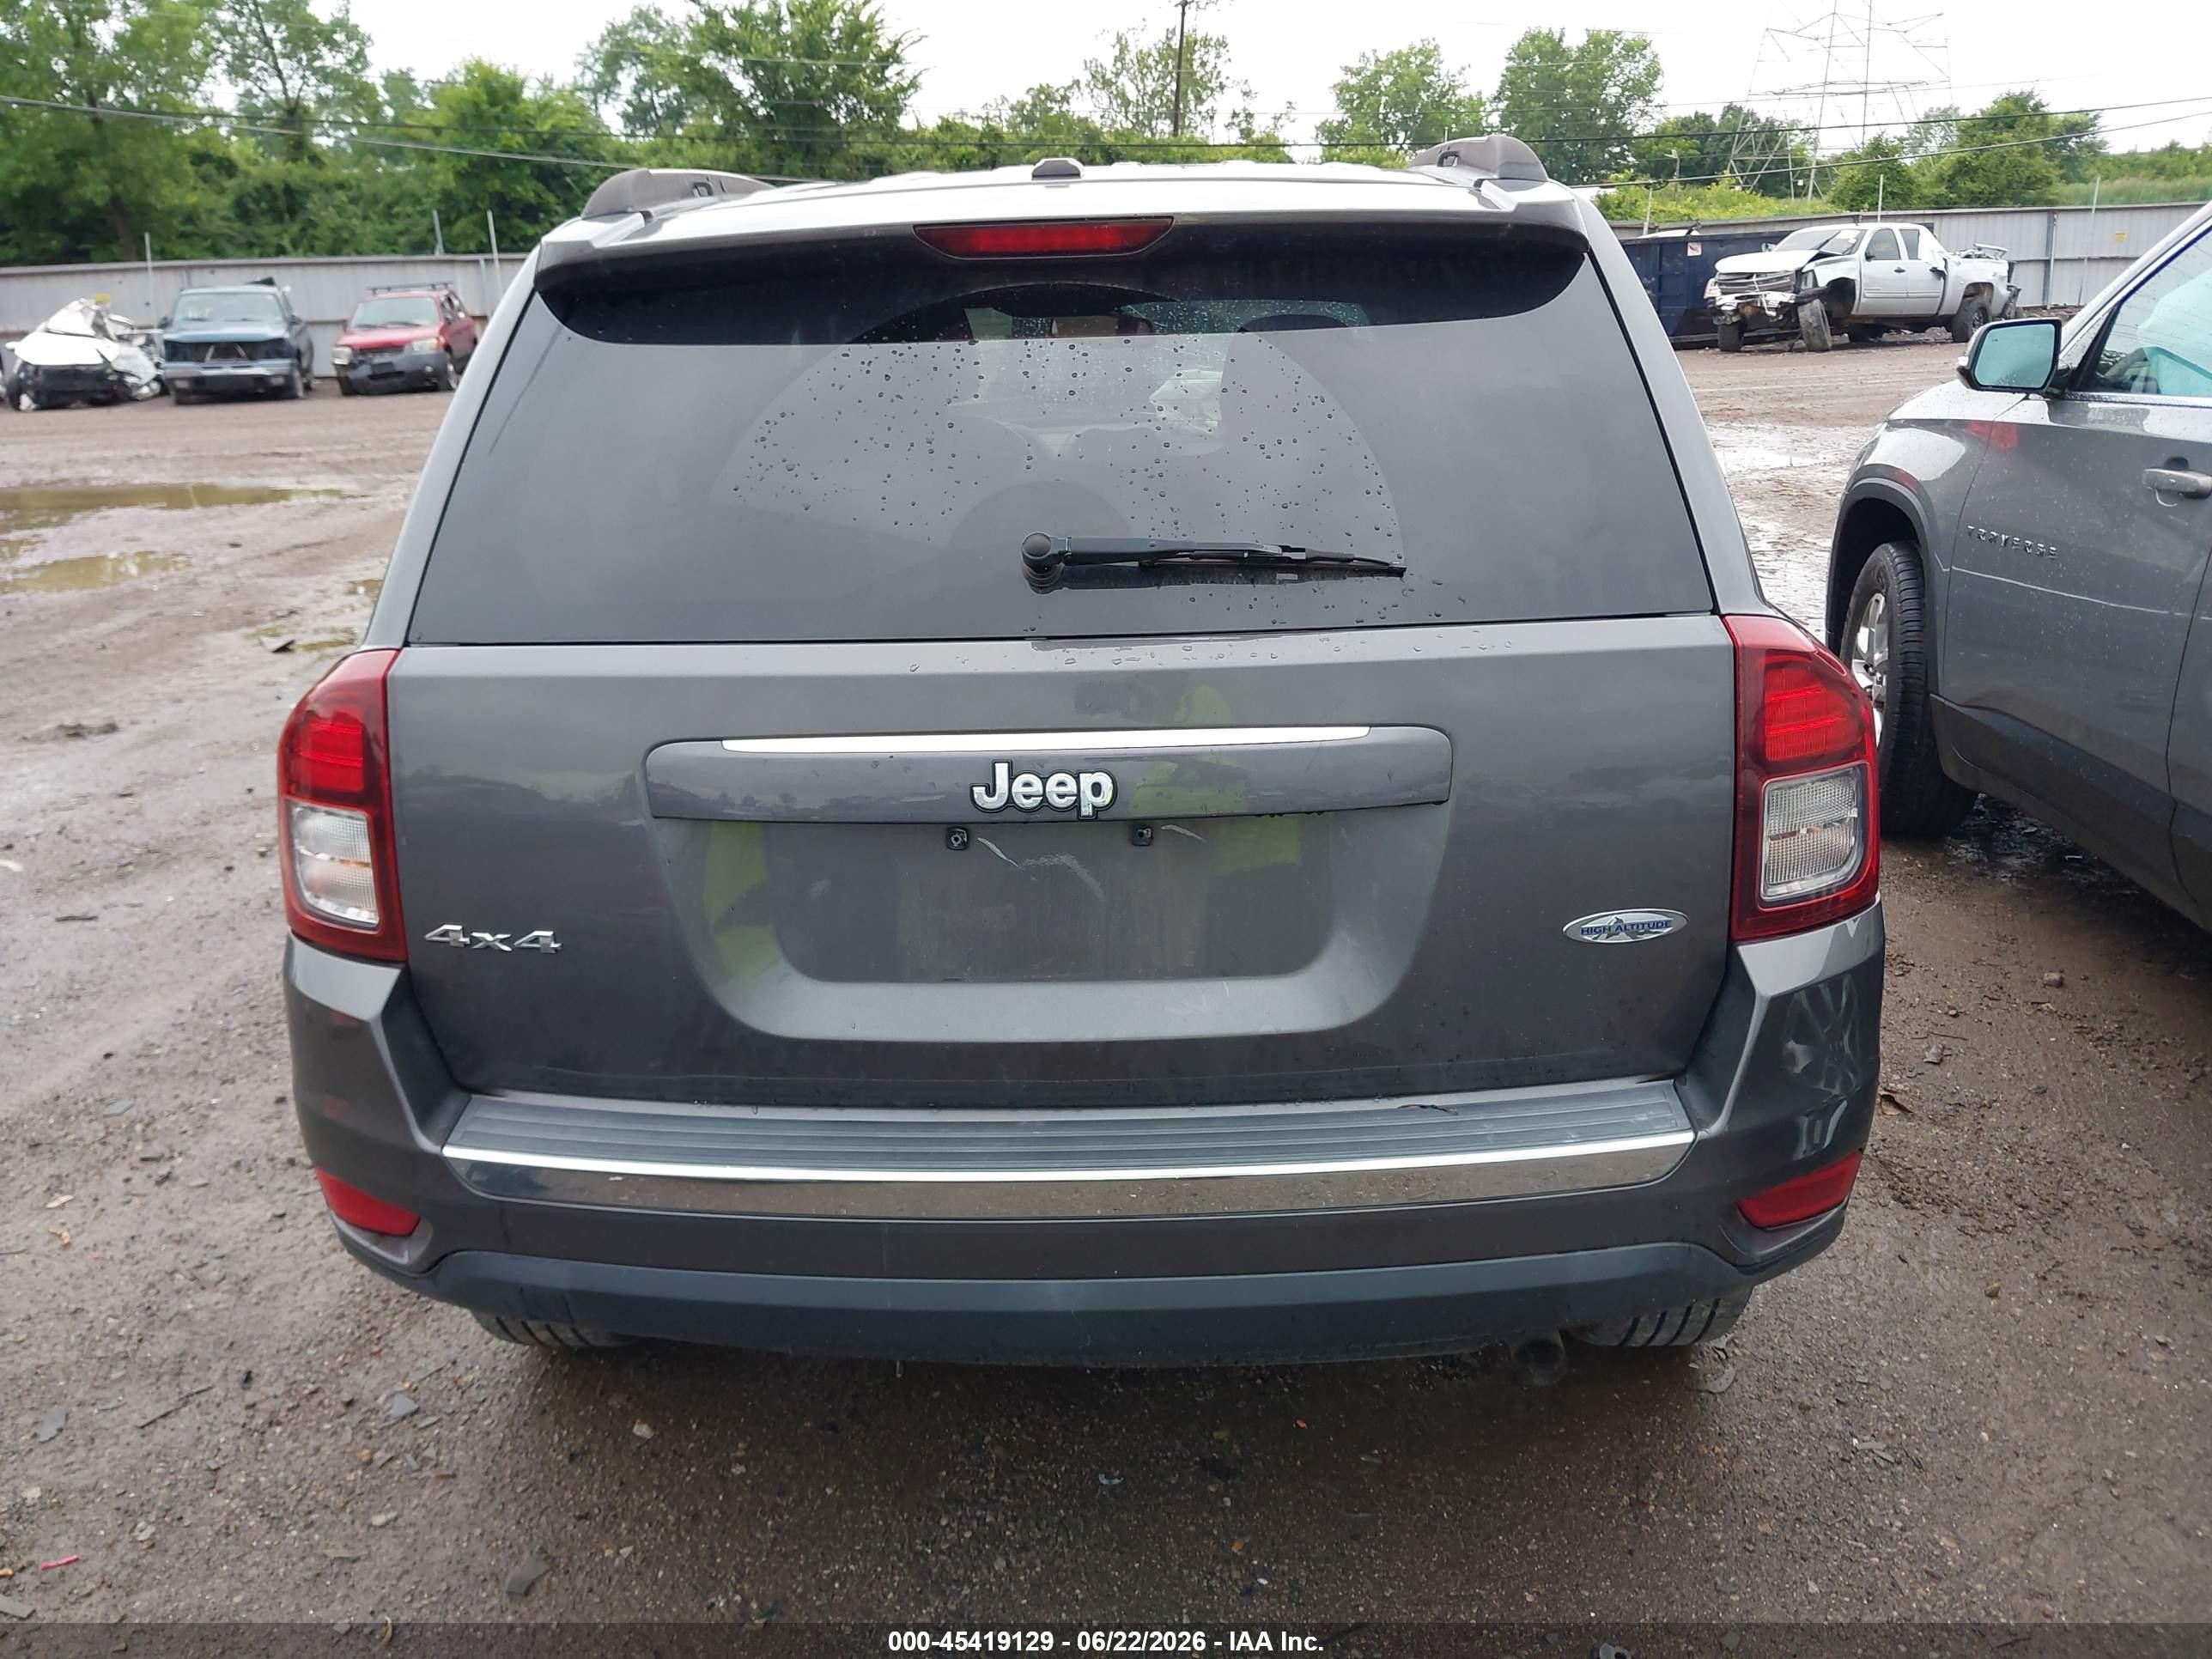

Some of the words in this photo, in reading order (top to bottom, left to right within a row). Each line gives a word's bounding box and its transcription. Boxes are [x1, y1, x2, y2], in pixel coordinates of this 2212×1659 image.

[1966, 525, 2057, 560] TRAVERSE
[971, 761, 1115, 819] Jeep
[424, 924, 562, 954] 4x4
[1580, 925, 1611, 935] HIGH
[1614, 919, 1672, 933] ALTITUDE
